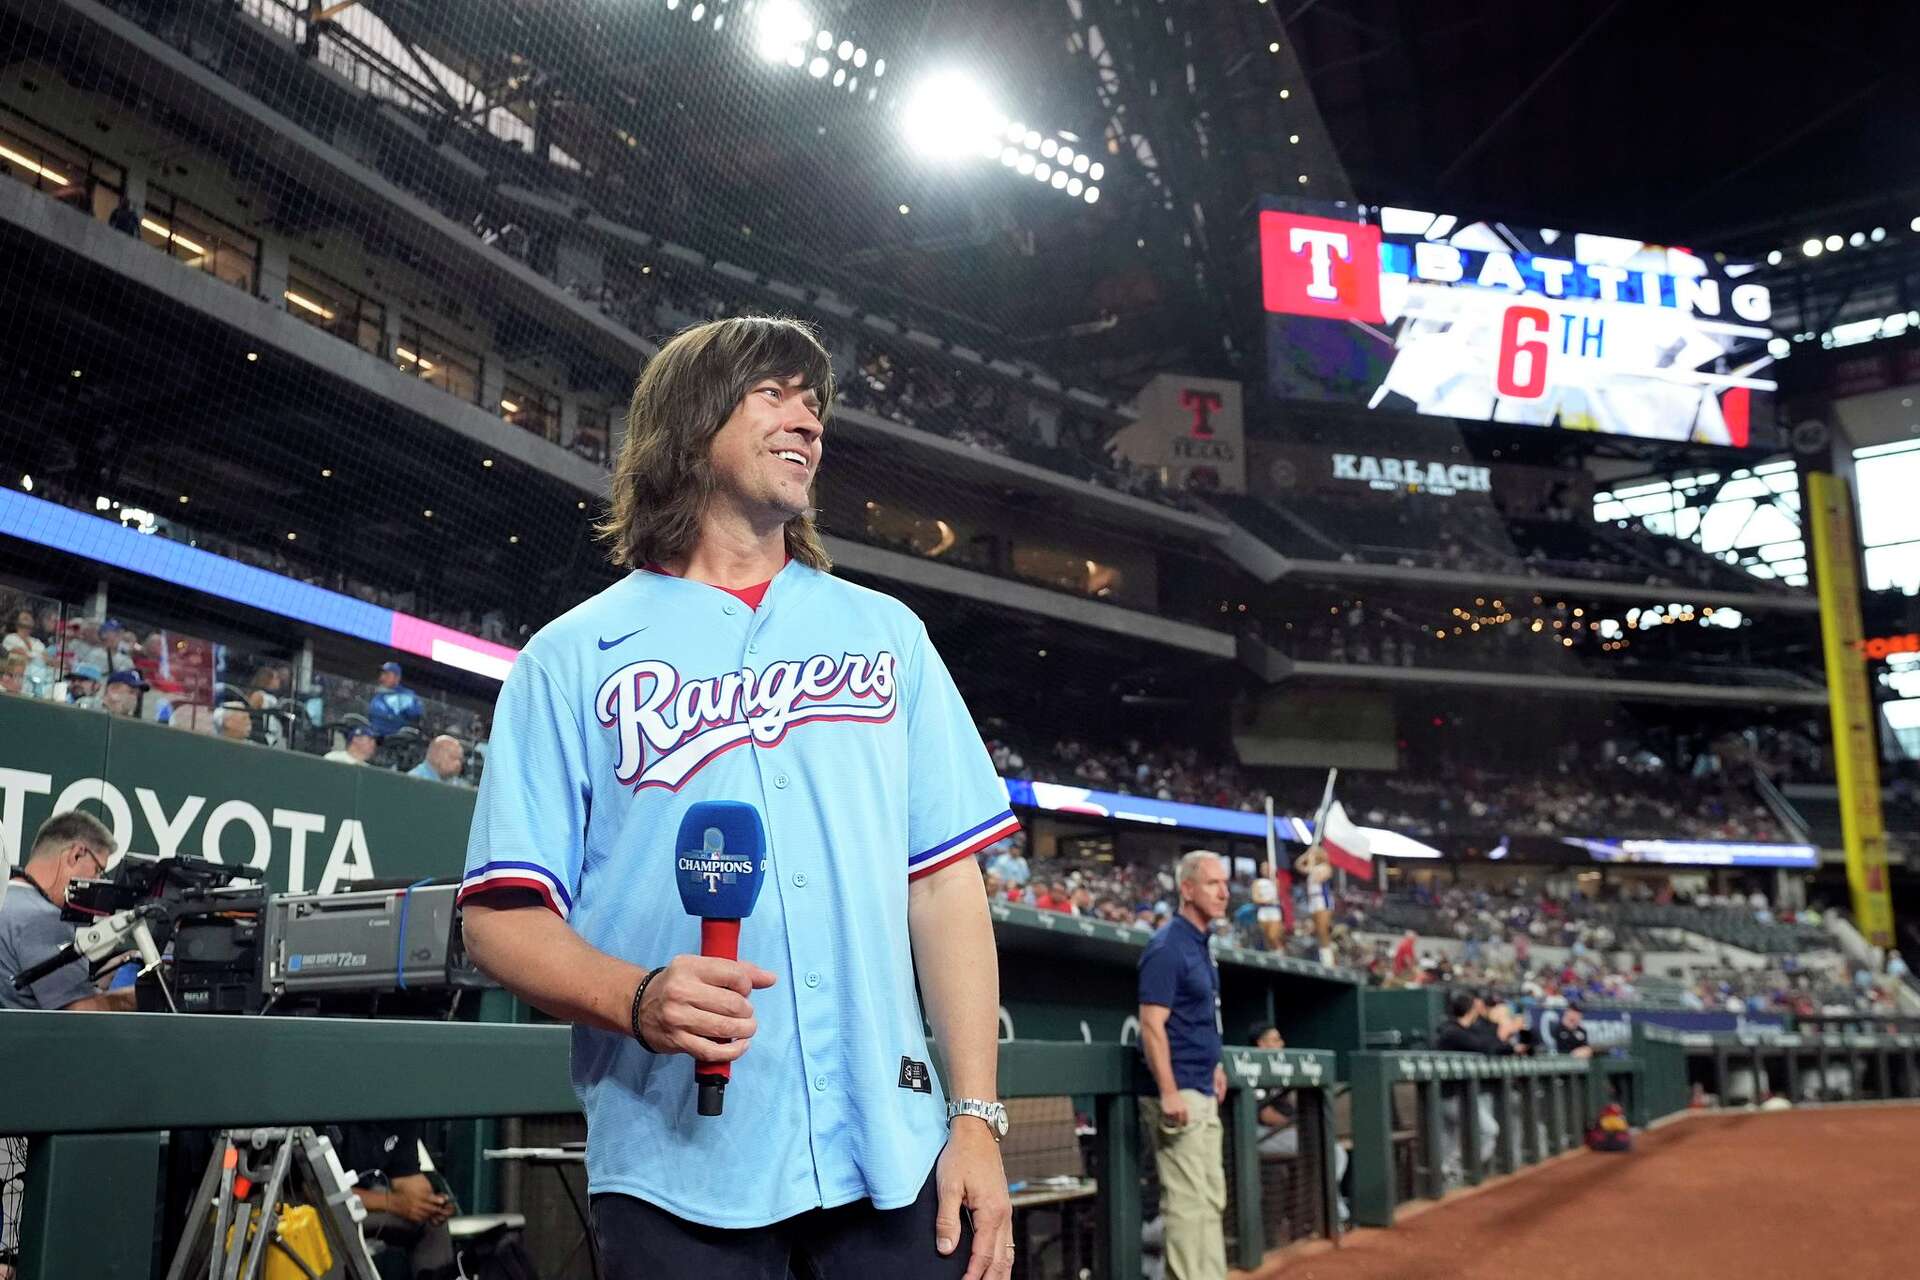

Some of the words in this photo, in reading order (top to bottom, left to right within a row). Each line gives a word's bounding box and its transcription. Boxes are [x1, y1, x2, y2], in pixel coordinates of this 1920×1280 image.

[1290, 227, 1349, 300] T
[1415, 242, 1773, 322] BATTING
[1178, 389, 1223, 441] T
[595, 651, 896, 797] Rangers
[0, 767, 374, 898] TOYOTA
[679, 858, 753, 874] CHAMPIONS
[703, 872, 721, 894] T
